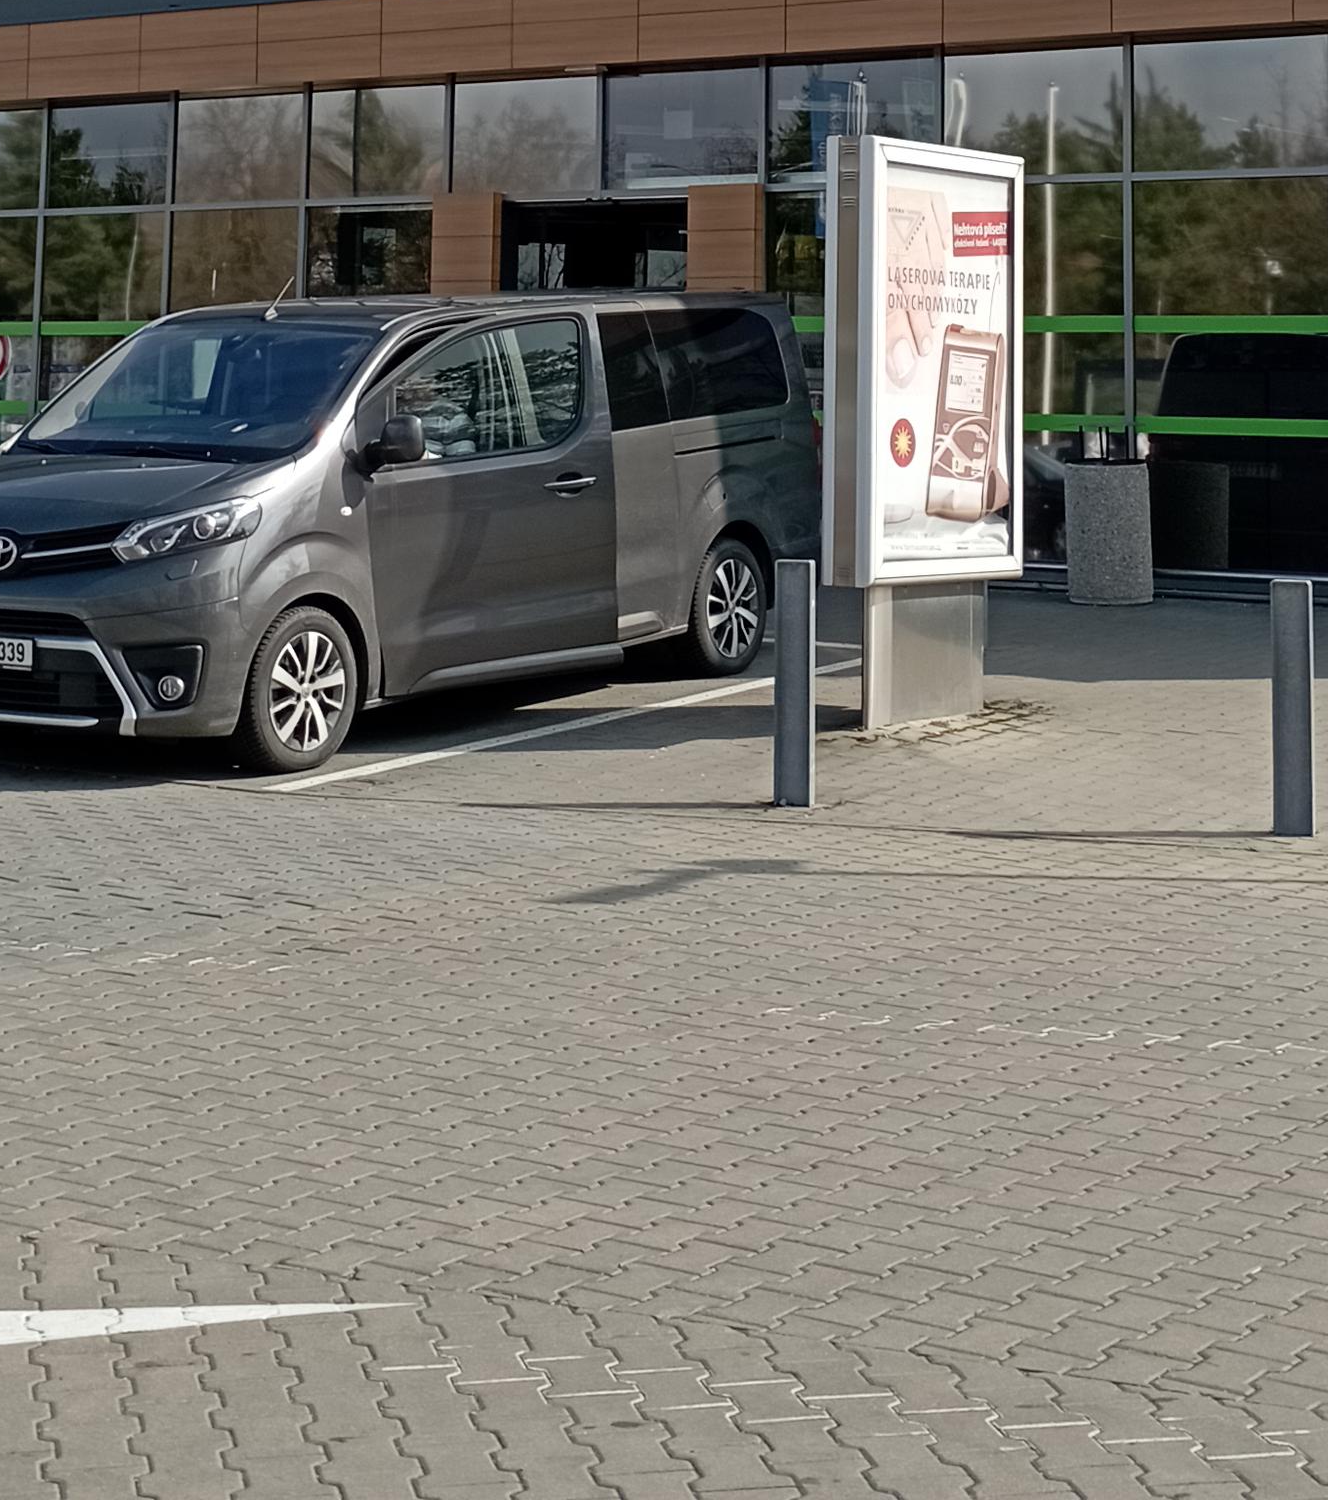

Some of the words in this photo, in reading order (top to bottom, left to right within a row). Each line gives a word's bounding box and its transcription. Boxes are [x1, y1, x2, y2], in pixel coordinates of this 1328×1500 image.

[888, 266, 946, 287] LASEROVÁ
[949, 271, 990, 290] TERAPIE
[888, 293, 978, 315] ONYCHOMYKÓZY
